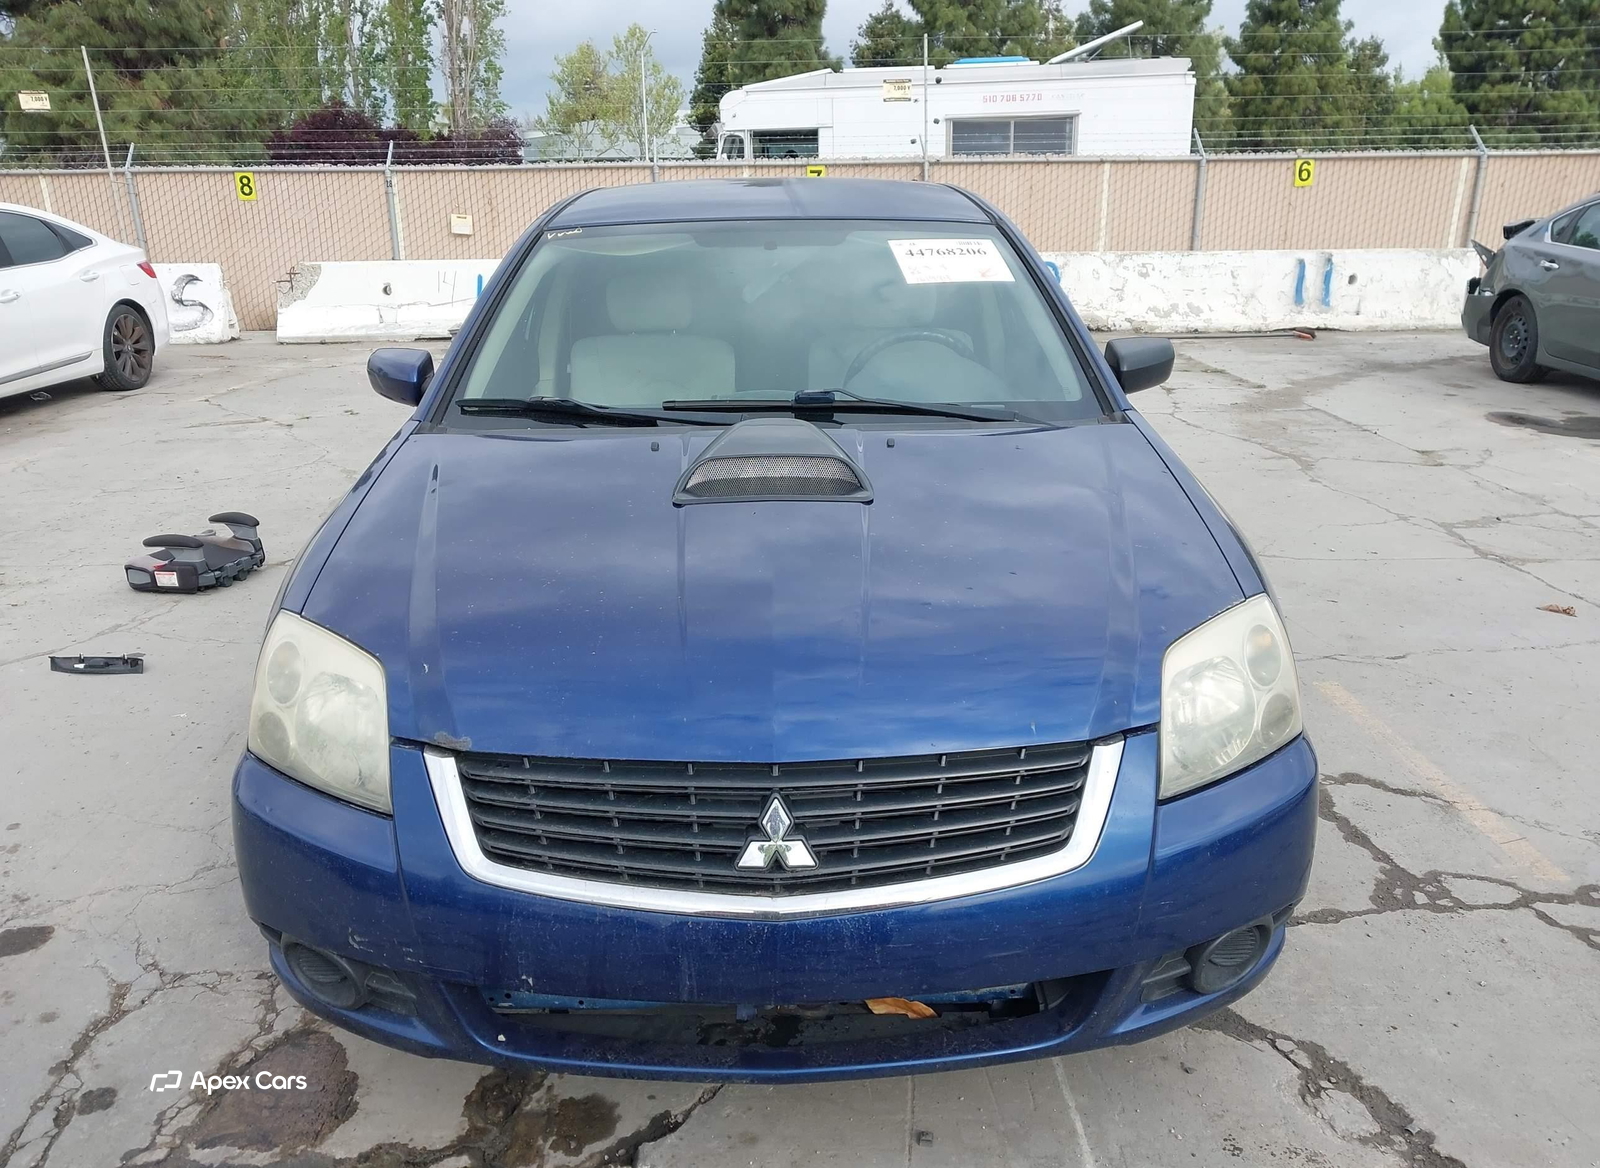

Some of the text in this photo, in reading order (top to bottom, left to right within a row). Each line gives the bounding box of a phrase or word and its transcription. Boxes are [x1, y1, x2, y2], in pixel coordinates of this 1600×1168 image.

[983, 95, 997, 103] 510
[1019, 93, 1043, 102] 5770
[1298, 161, 1312, 182] 6
[238, 175, 253, 196] 8
[905, 247, 987, 256] 44768206
